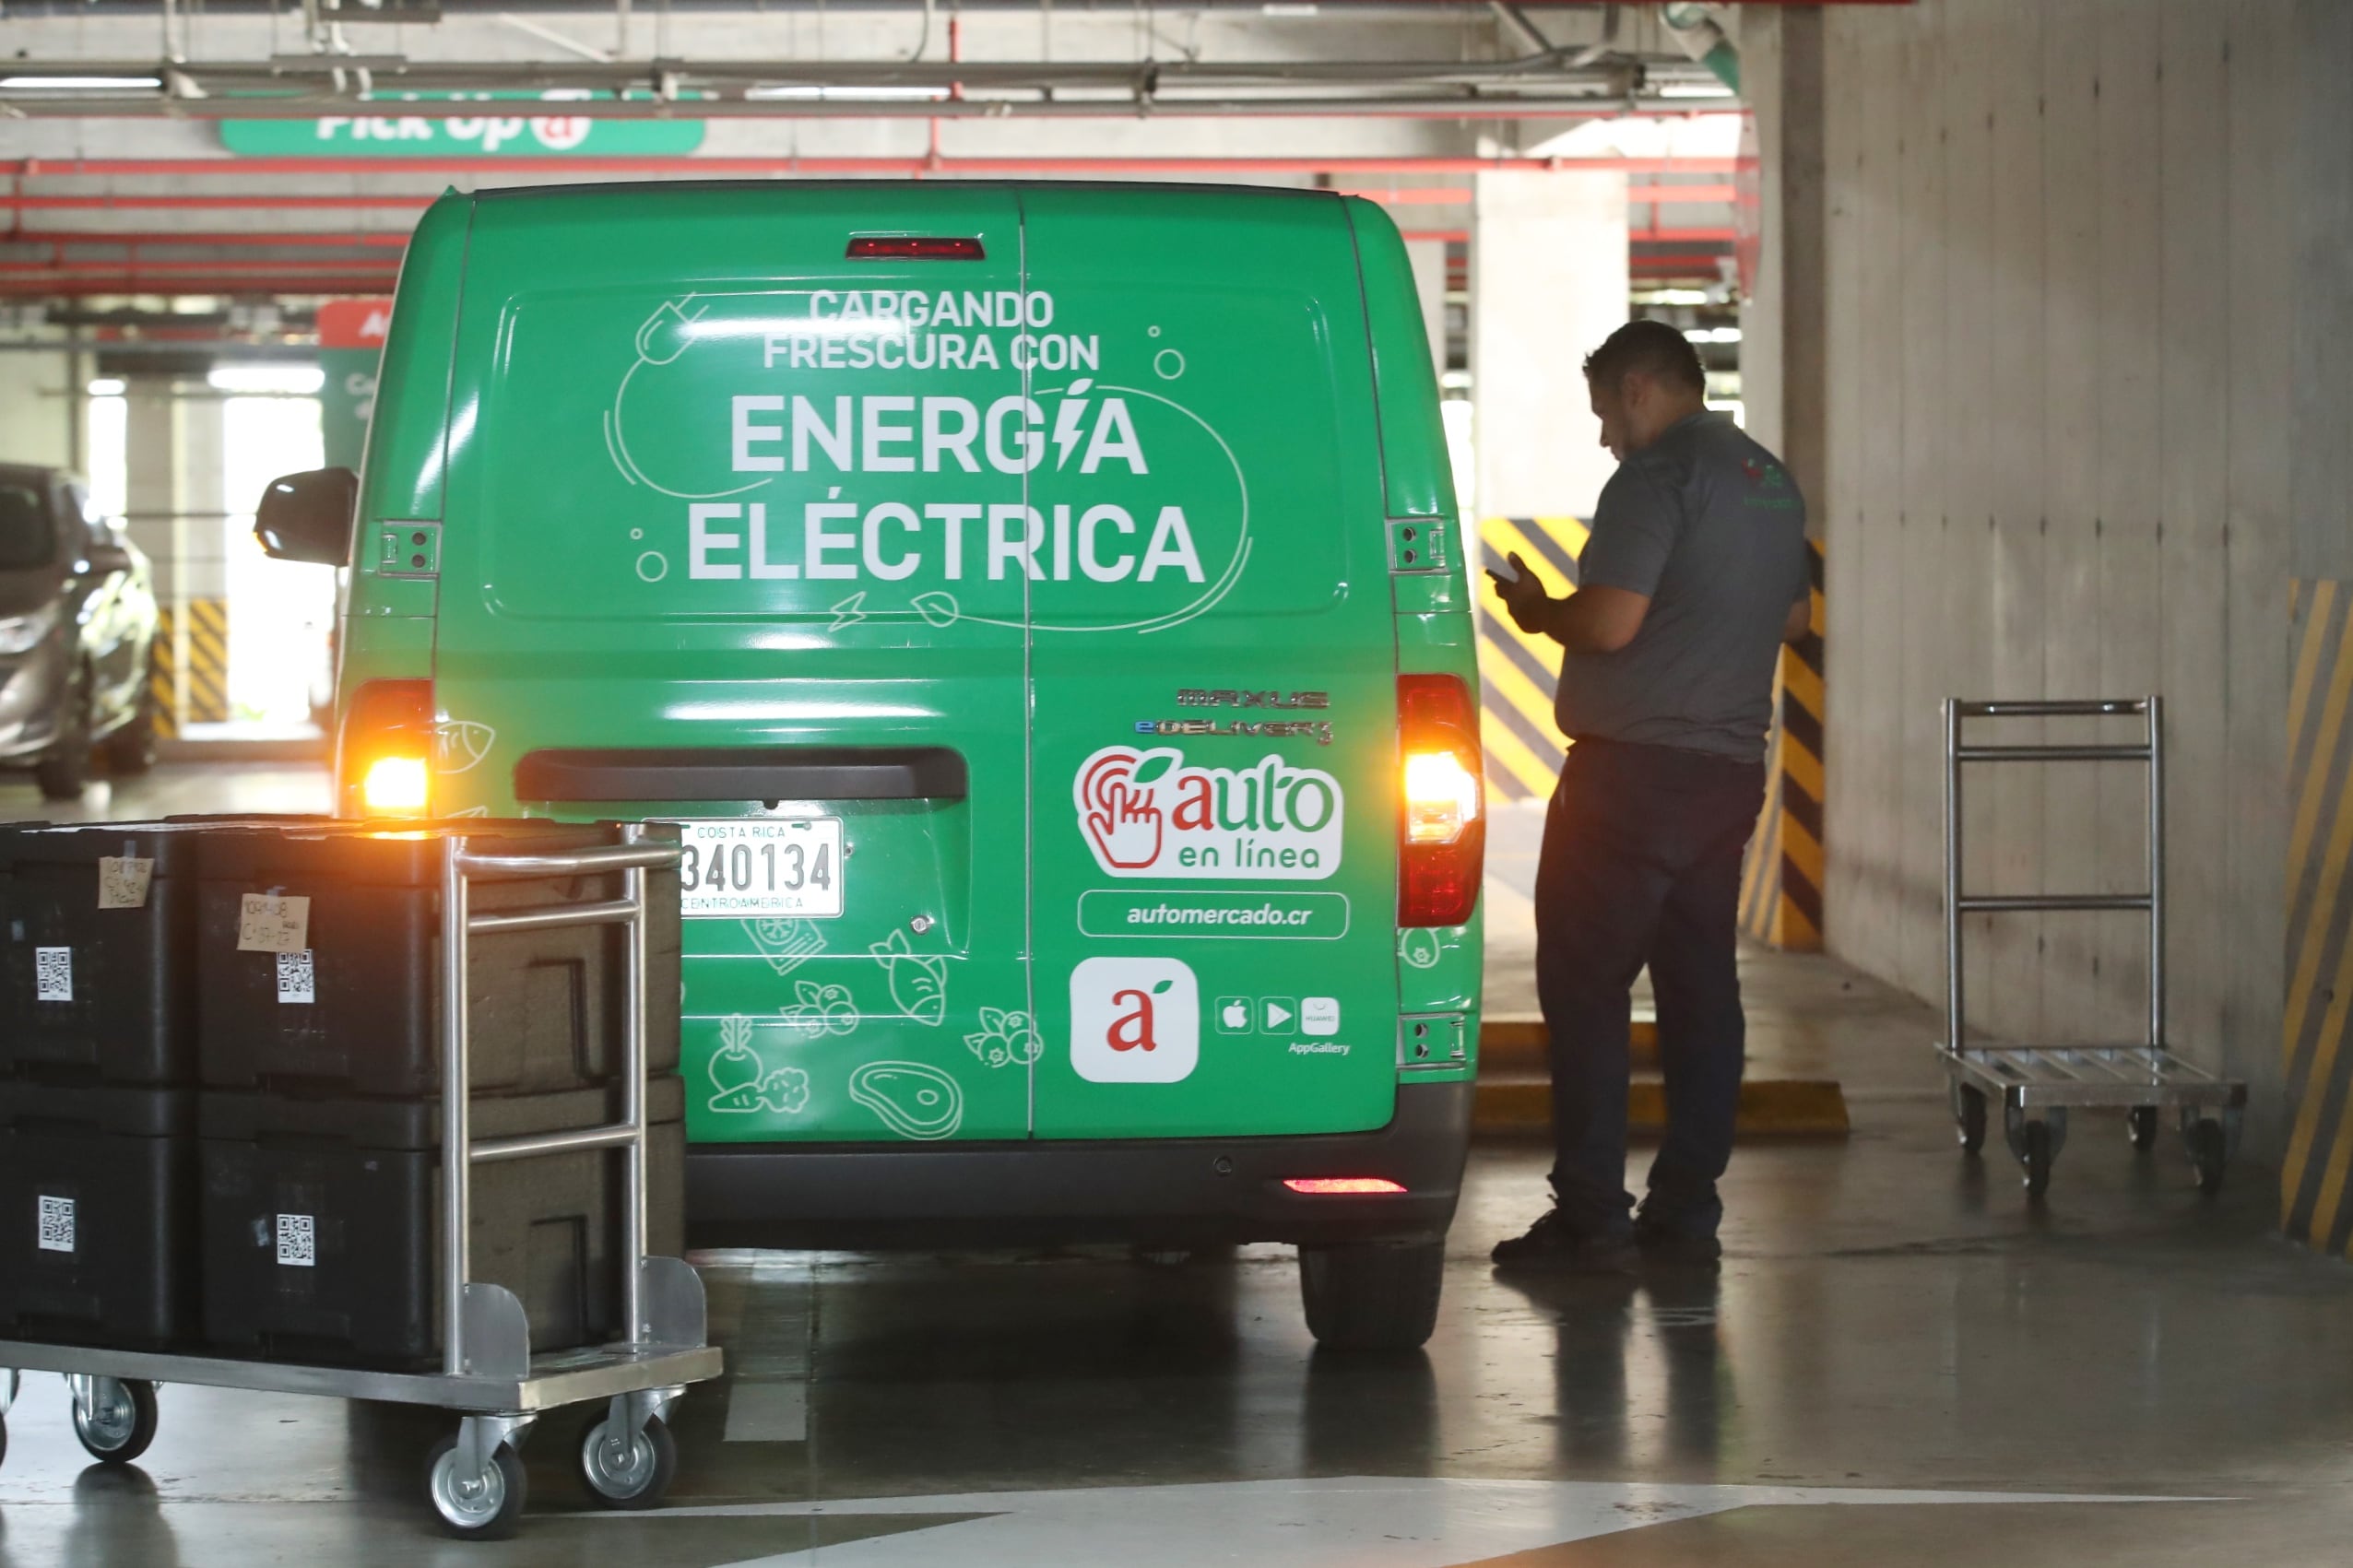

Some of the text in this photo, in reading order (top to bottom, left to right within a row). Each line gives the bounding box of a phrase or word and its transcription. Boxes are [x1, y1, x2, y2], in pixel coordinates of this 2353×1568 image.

[809, 289, 1055, 329] CARGANDO
[763, 334, 1100, 371] FRESCURA CON
[731, 377, 1150, 476] ENERGÍA
[688, 486, 1206, 584] ELÉCTRICA
[1172, 763, 1335, 833] auto
[697, 826, 786, 839] COSTA RICA
[1178, 837, 1319, 868] en línea
[681, 897, 804, 910] CENTROAMERICA
[1127, 903, 1313, 926] automercado.cr
[1288, 1042, 1351, 1056] AppGallery
